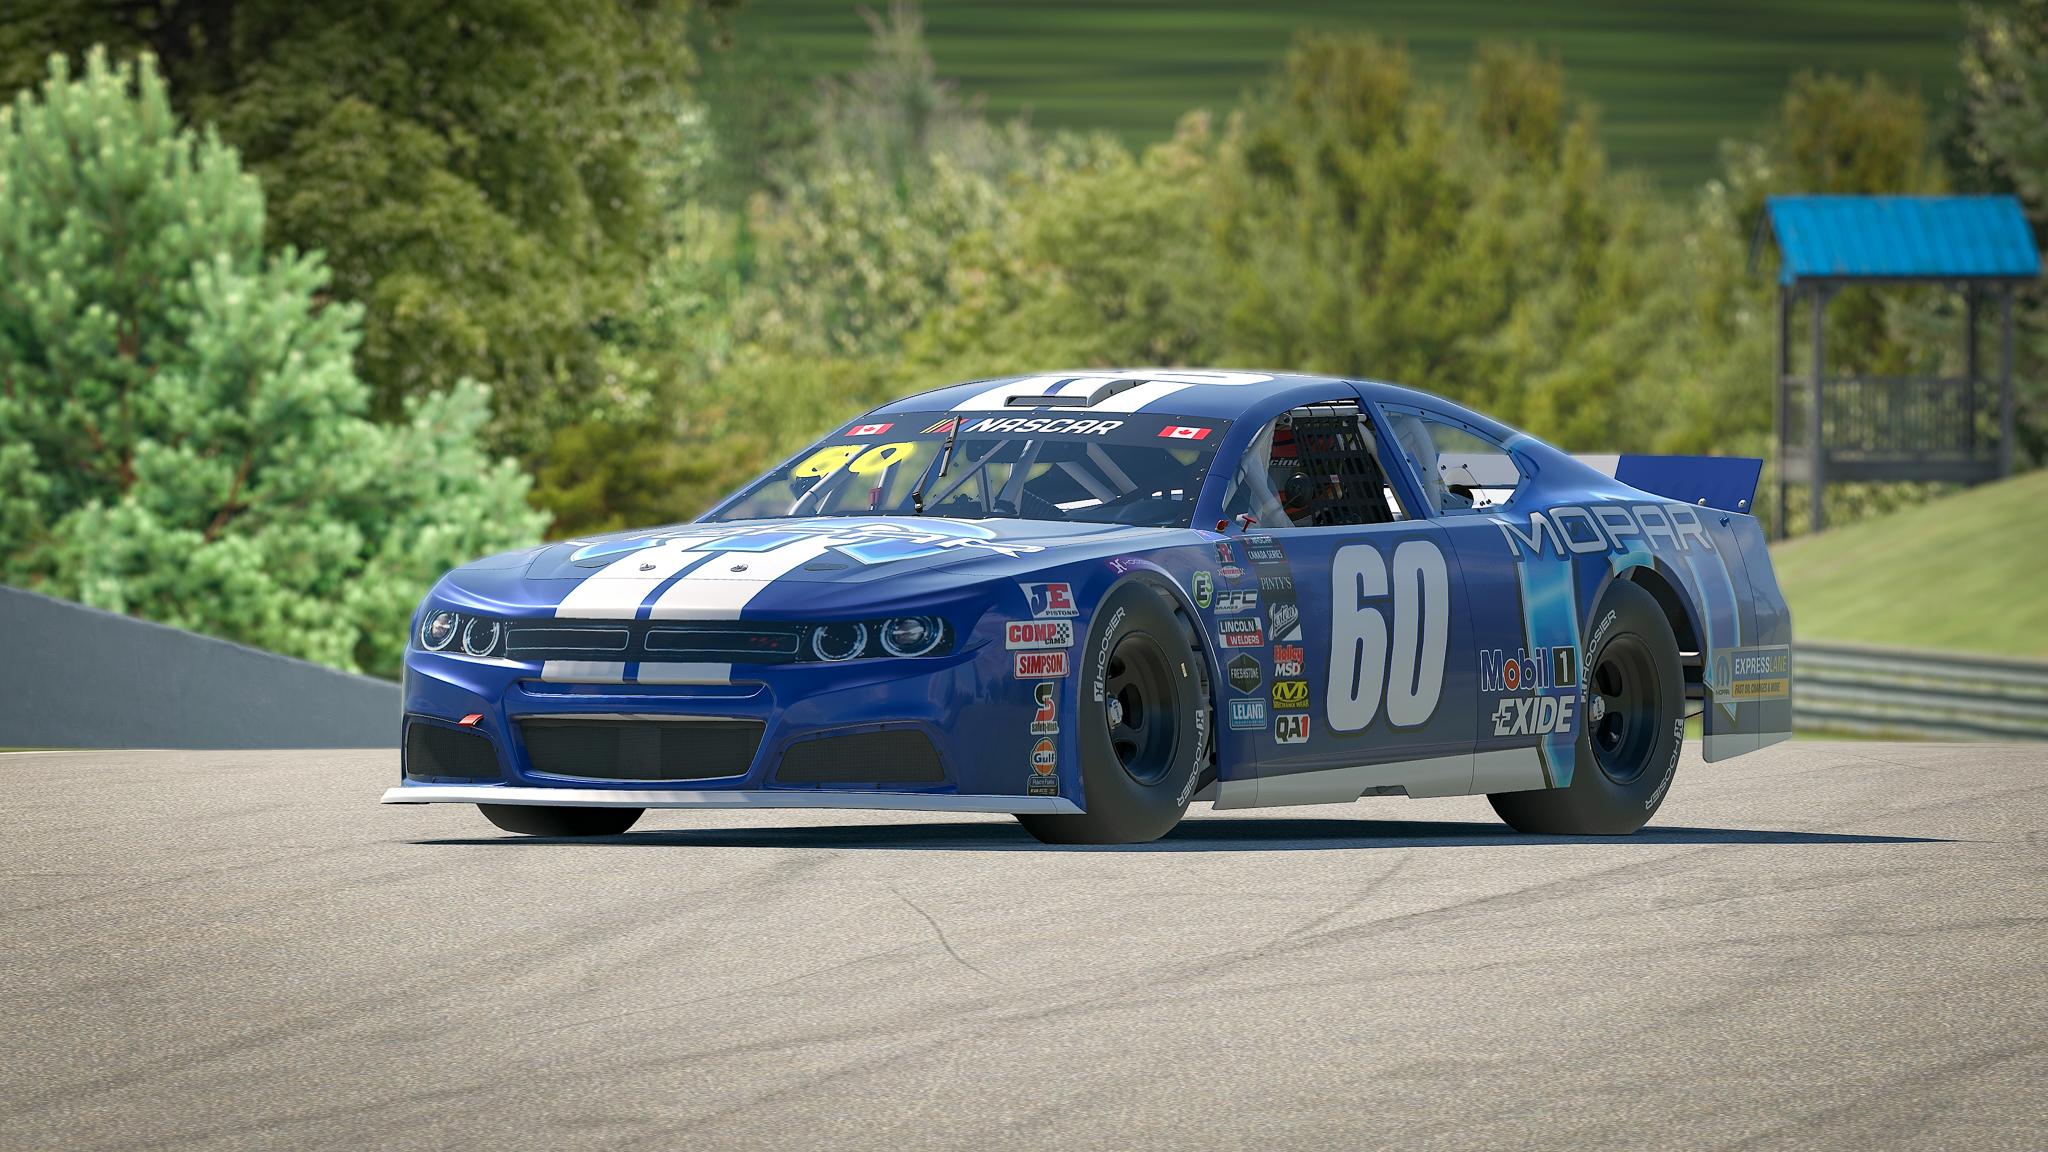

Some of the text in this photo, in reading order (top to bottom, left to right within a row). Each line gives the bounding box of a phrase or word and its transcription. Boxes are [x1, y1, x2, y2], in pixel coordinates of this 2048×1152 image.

[968, 418, 1124, 436] NASCAR
[793, 441, 914, 478] 60
[1488, 505, 1713, 558] MOPAR
[1247, 549, 1267, 560] CANADA
[1267, 548, 1283, 559] SERIES
[1260, 576, 1292, 590] PINTY'S
[1031, 583, 1071, 616] JE
[1216, 590, 1258, 606] PFC
[1008, 623, 1057, 643] COMP
[1220, 620, 1254, 633] LINCOLN
[1327, 540, 1449, 731] 60
[1045, 637, 1066, 645] CAMS
[1096, 606, 1126, 680] HOOSIER
[1230, 634, 1260, 645] WELDERS
[1582, 609, 1617, 687] HOOSIER
[1274, 645, 1304, 662] Holley
[1019, 654, 1063, 675] SIMPSON
[1275, 662, 1301, 677] MSD
[1480, 647, 1550, 692] Mobil
[1232, 703, 1265, 720] LELAND
[1491, 695, 1576, 738] EXIDE
[1275, 715, 1309, 742] QA1
[1033, 752, 1055, 764] Gulf
[1177, 729, 1204, 808] HOOSIER
[1645, 742, 1686, 811] HOOSIER
